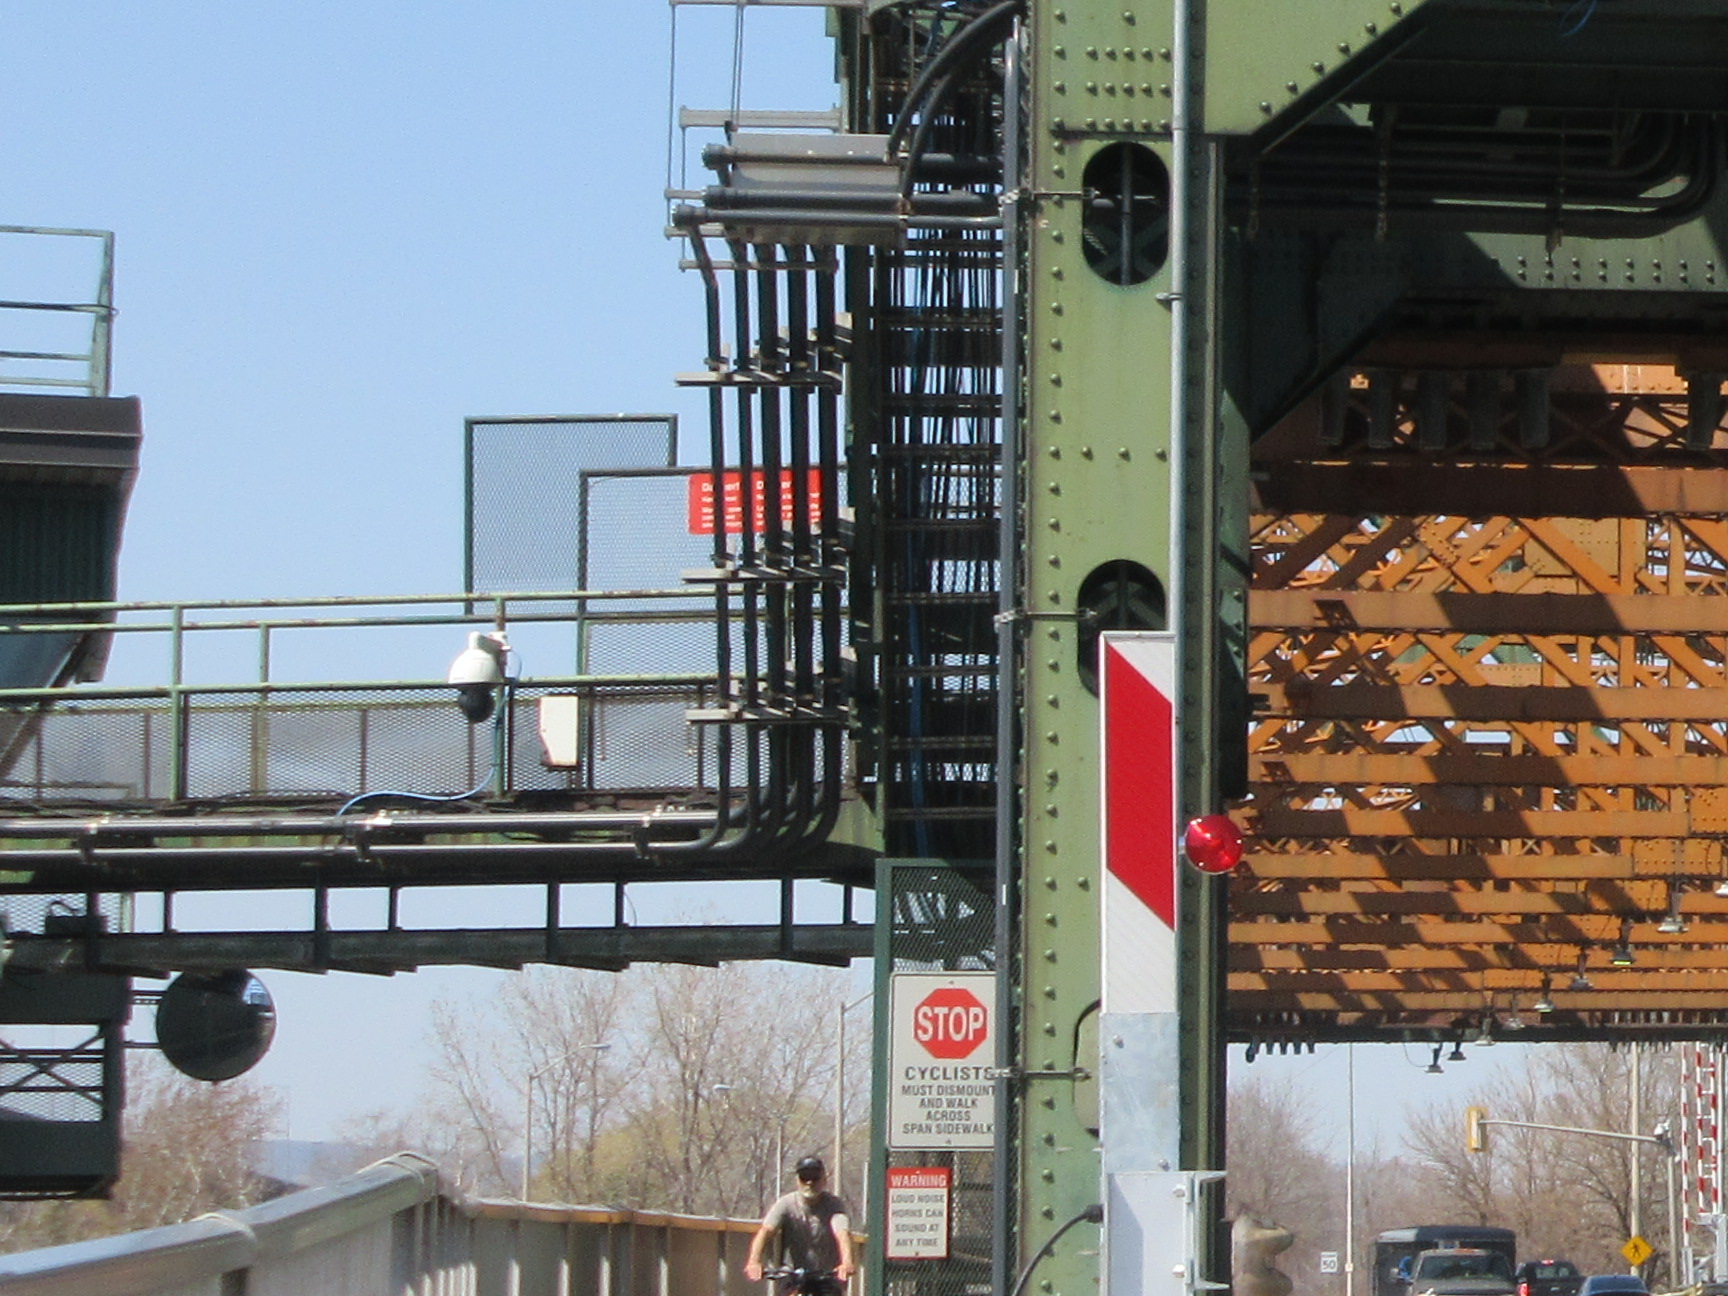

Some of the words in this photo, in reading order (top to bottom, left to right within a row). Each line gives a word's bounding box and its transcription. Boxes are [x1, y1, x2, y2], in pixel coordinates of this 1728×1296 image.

[917, 1005, 984, 1042] STOP
[905, 1066, 996, 1081] CYCLISTS
[902, 1085, 933, 1096] MUST
[936, 1085, 995, 1096] DISMOUNT
[919, 1097, 942, 1108] AND
[945, 1097, 978, 1108] WALK
[926, 1110, 971, 1122] ACROSS
[903, 1123, 933, 1134] SPAN
[936, 1123, 994, 1134] SIDEWALK
[891, 1174, 946, 1187] WARNING
[892, 1194, 915, 1203] LOUD
[917, 1194, 945, 1203] NOISE
[925, 1209, 943, 1217] CAN
[895, 1223, 927, 1232] SOUND
[895, 1238, 914, 1247] ANY
[916, 1238, 938, 1246] TIME
[1322, 1259, 1336, 1270] 50
